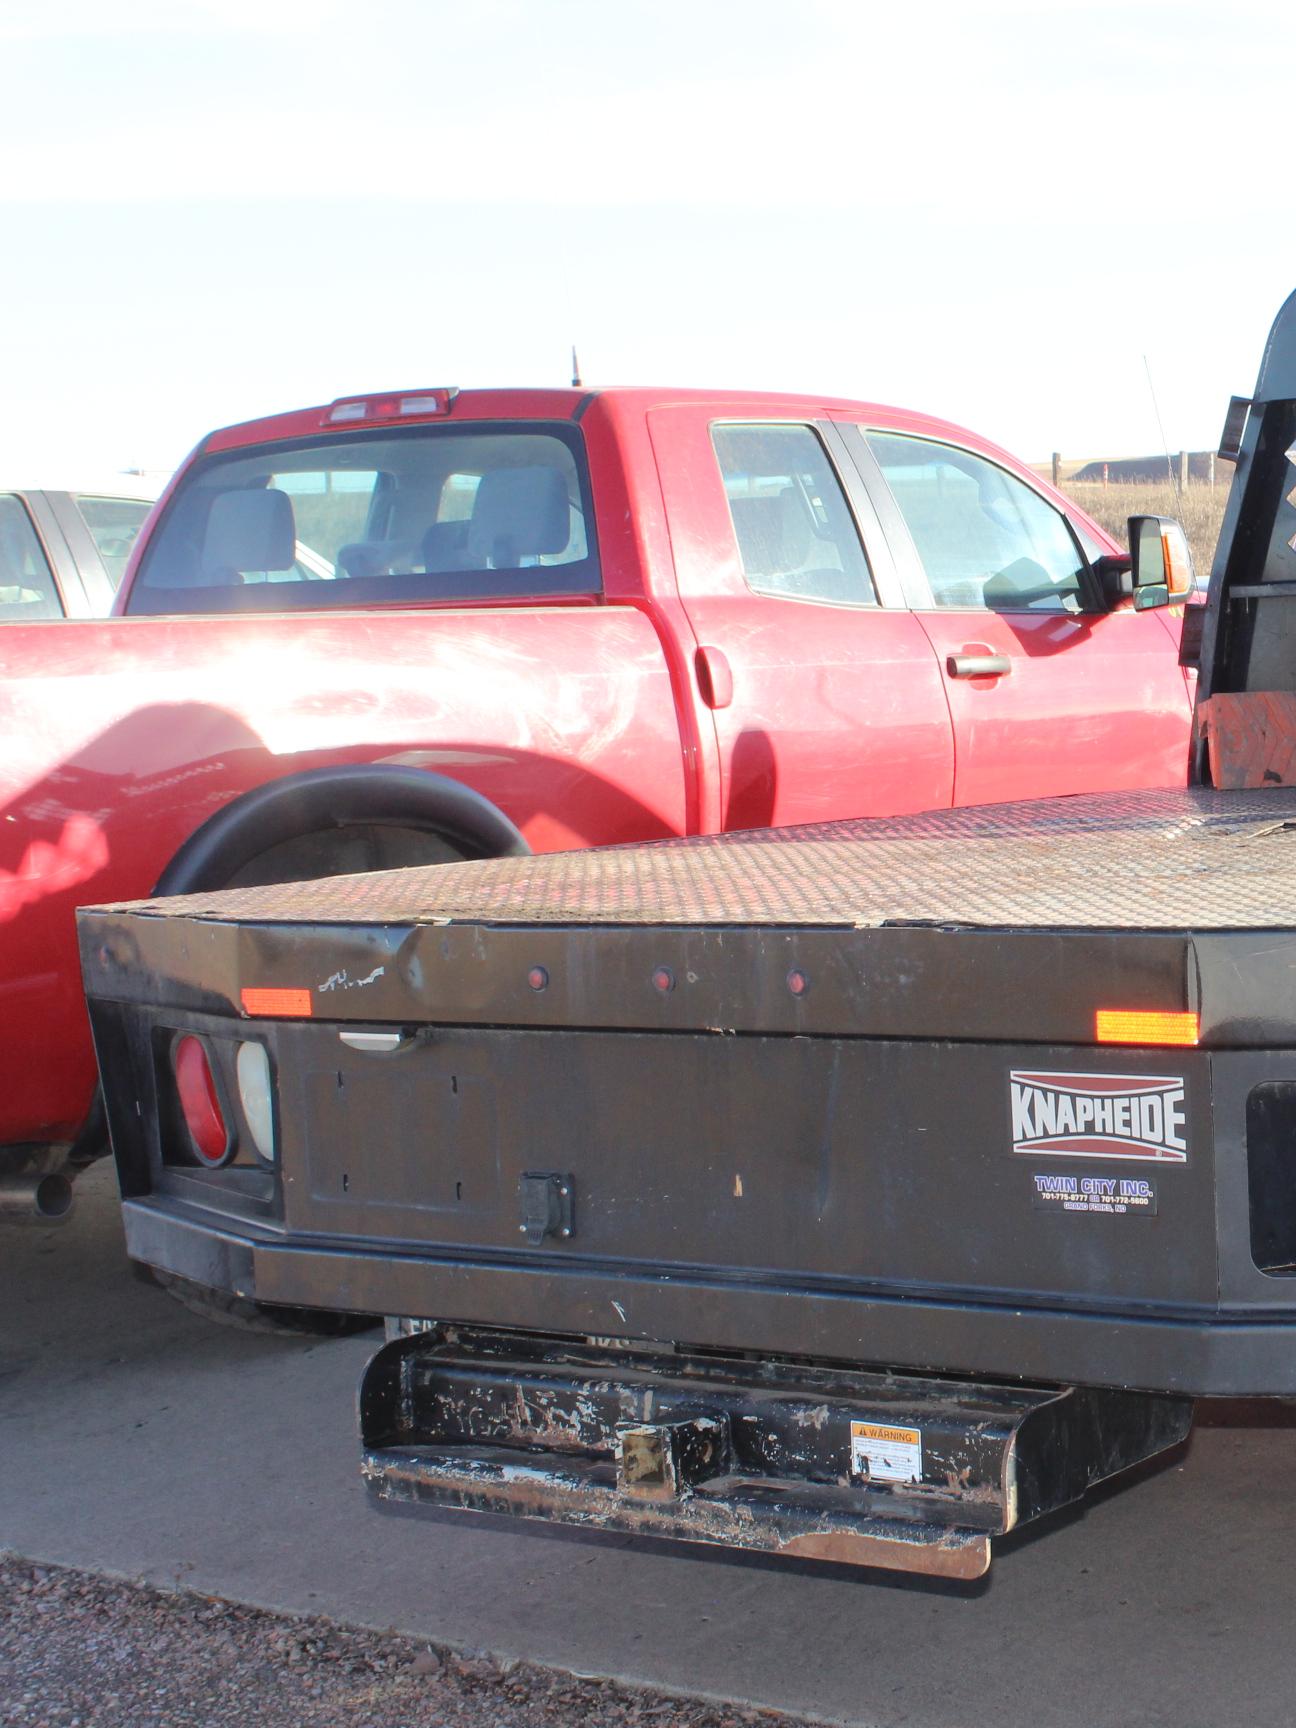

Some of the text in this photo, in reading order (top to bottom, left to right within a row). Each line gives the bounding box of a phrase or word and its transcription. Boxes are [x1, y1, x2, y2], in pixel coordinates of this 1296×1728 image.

[1010, 1083, 1187, 1150] KNAPHEIDE
[1034, 1175, 1154, 1198] TWIN CITY INC.
[1063, 1202, 1088, 1210] GRAND
[1115, 1205, 1126, 1213] ND
[868, 1428, 912, 1442] WARNING
